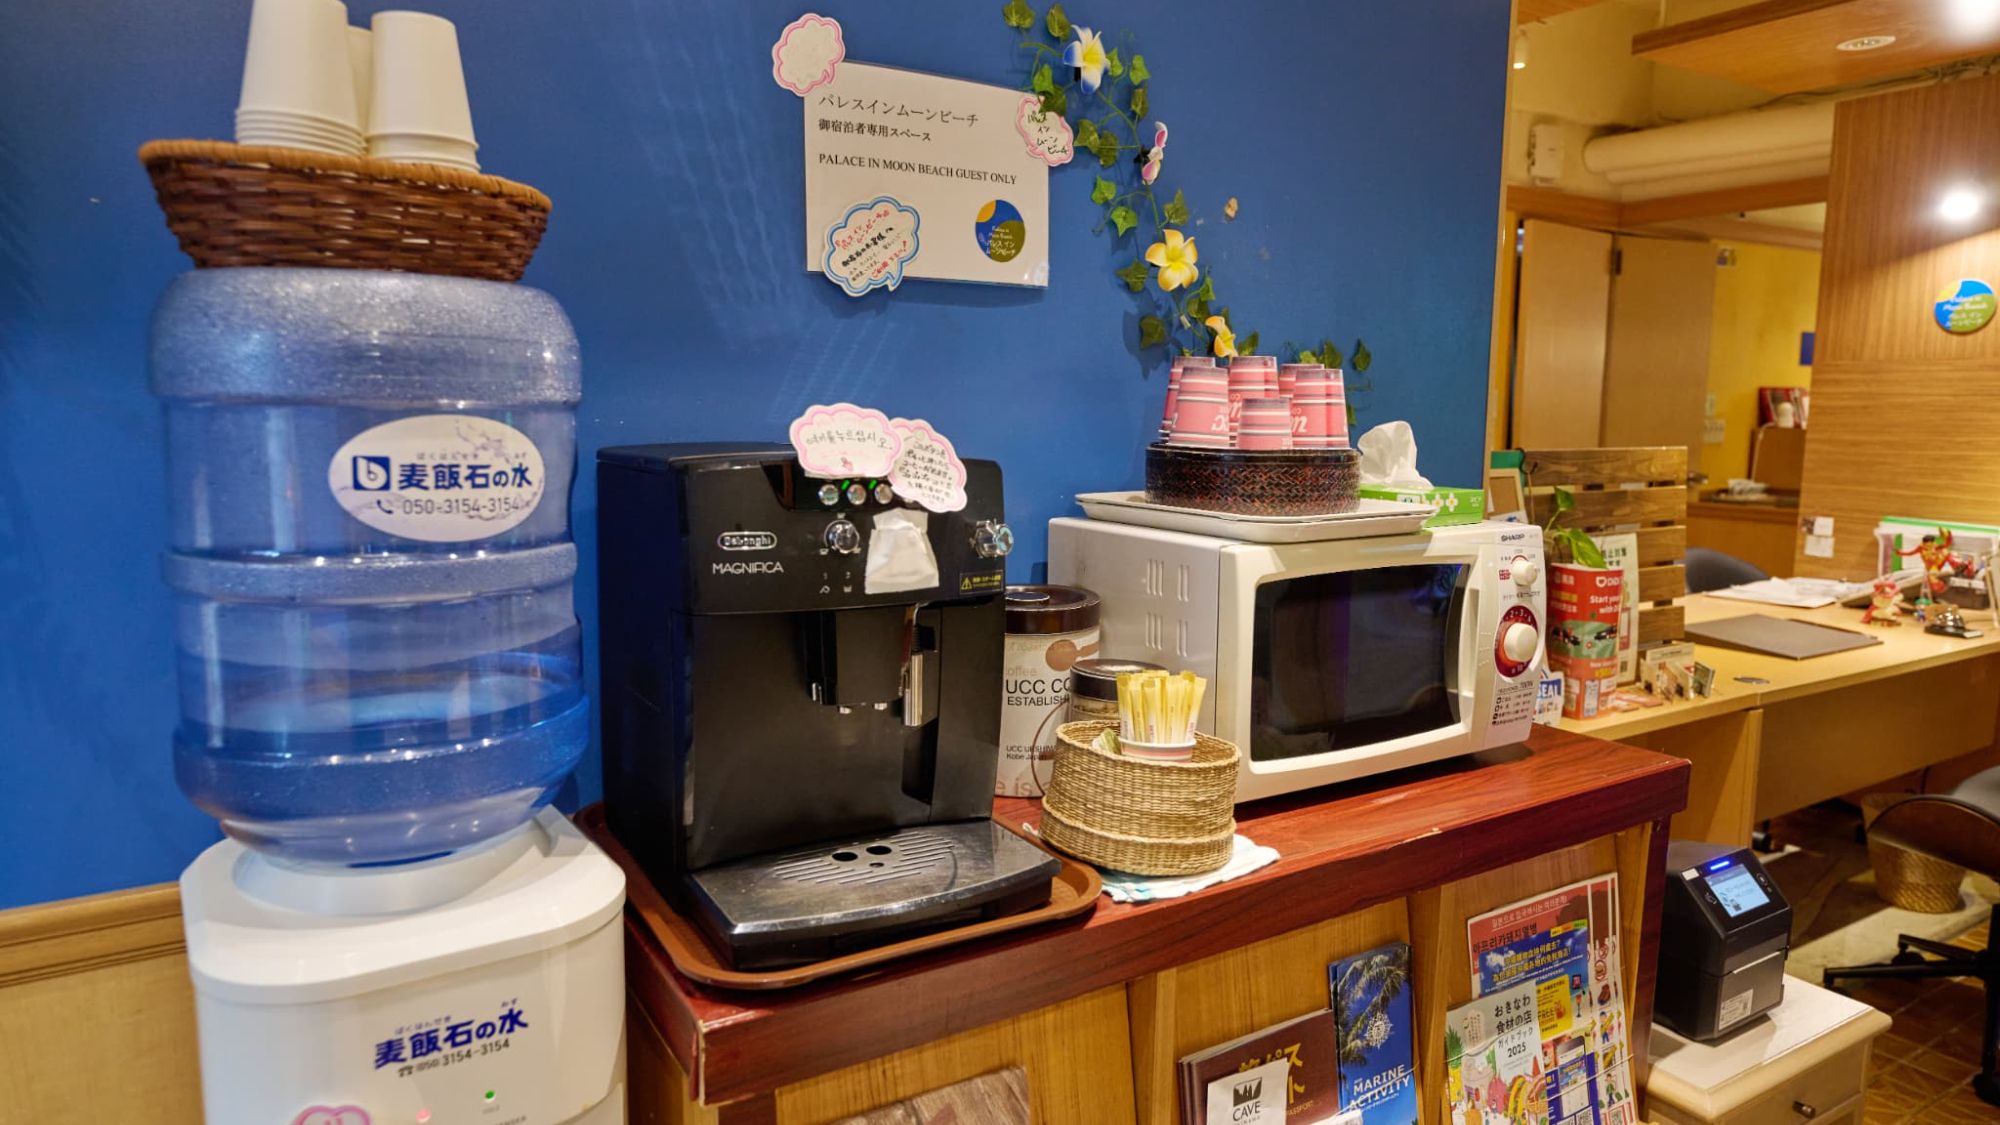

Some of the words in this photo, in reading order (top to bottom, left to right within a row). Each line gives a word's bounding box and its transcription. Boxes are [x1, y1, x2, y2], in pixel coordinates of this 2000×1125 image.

[818, 94, 979, 128] パレスインムーンビーチ
[818, 118, 932, 142] 御宿泊者専用スペース
[819, 153, 866, 168] PALACE
[868, 157, 881, 168] IN
[883, 159, 916, 173] MOON
[918, 163, 954, 177] BEACH
[955, 168, 989, 182] GUEST
[990, 171, 1018, 185] ONLY
[398, 462, 533, 491] 麦飯石の水
[402, 497, 520, 515] 050-3154-3154
[712, 561, 784, 575] MAGNIFICA
[1006, 679, 1046, 695] UCC
[1494, 993, 1531, 1018] おきなわ
[1496, 1010, 1532, 1035] 食材の店
[374, 1008, 529, 1070] 麦飯石の水
[1498, 1027, 1533, 1048] ガイドブック
[1508, 1042, 1527, 1058] 2025
[1354, 1064, 1405, 1096] MARINE
[1349, 1075, 1411, 1112] ACTIVITY
[1232, 1100, 1261, 1122] CAVE
